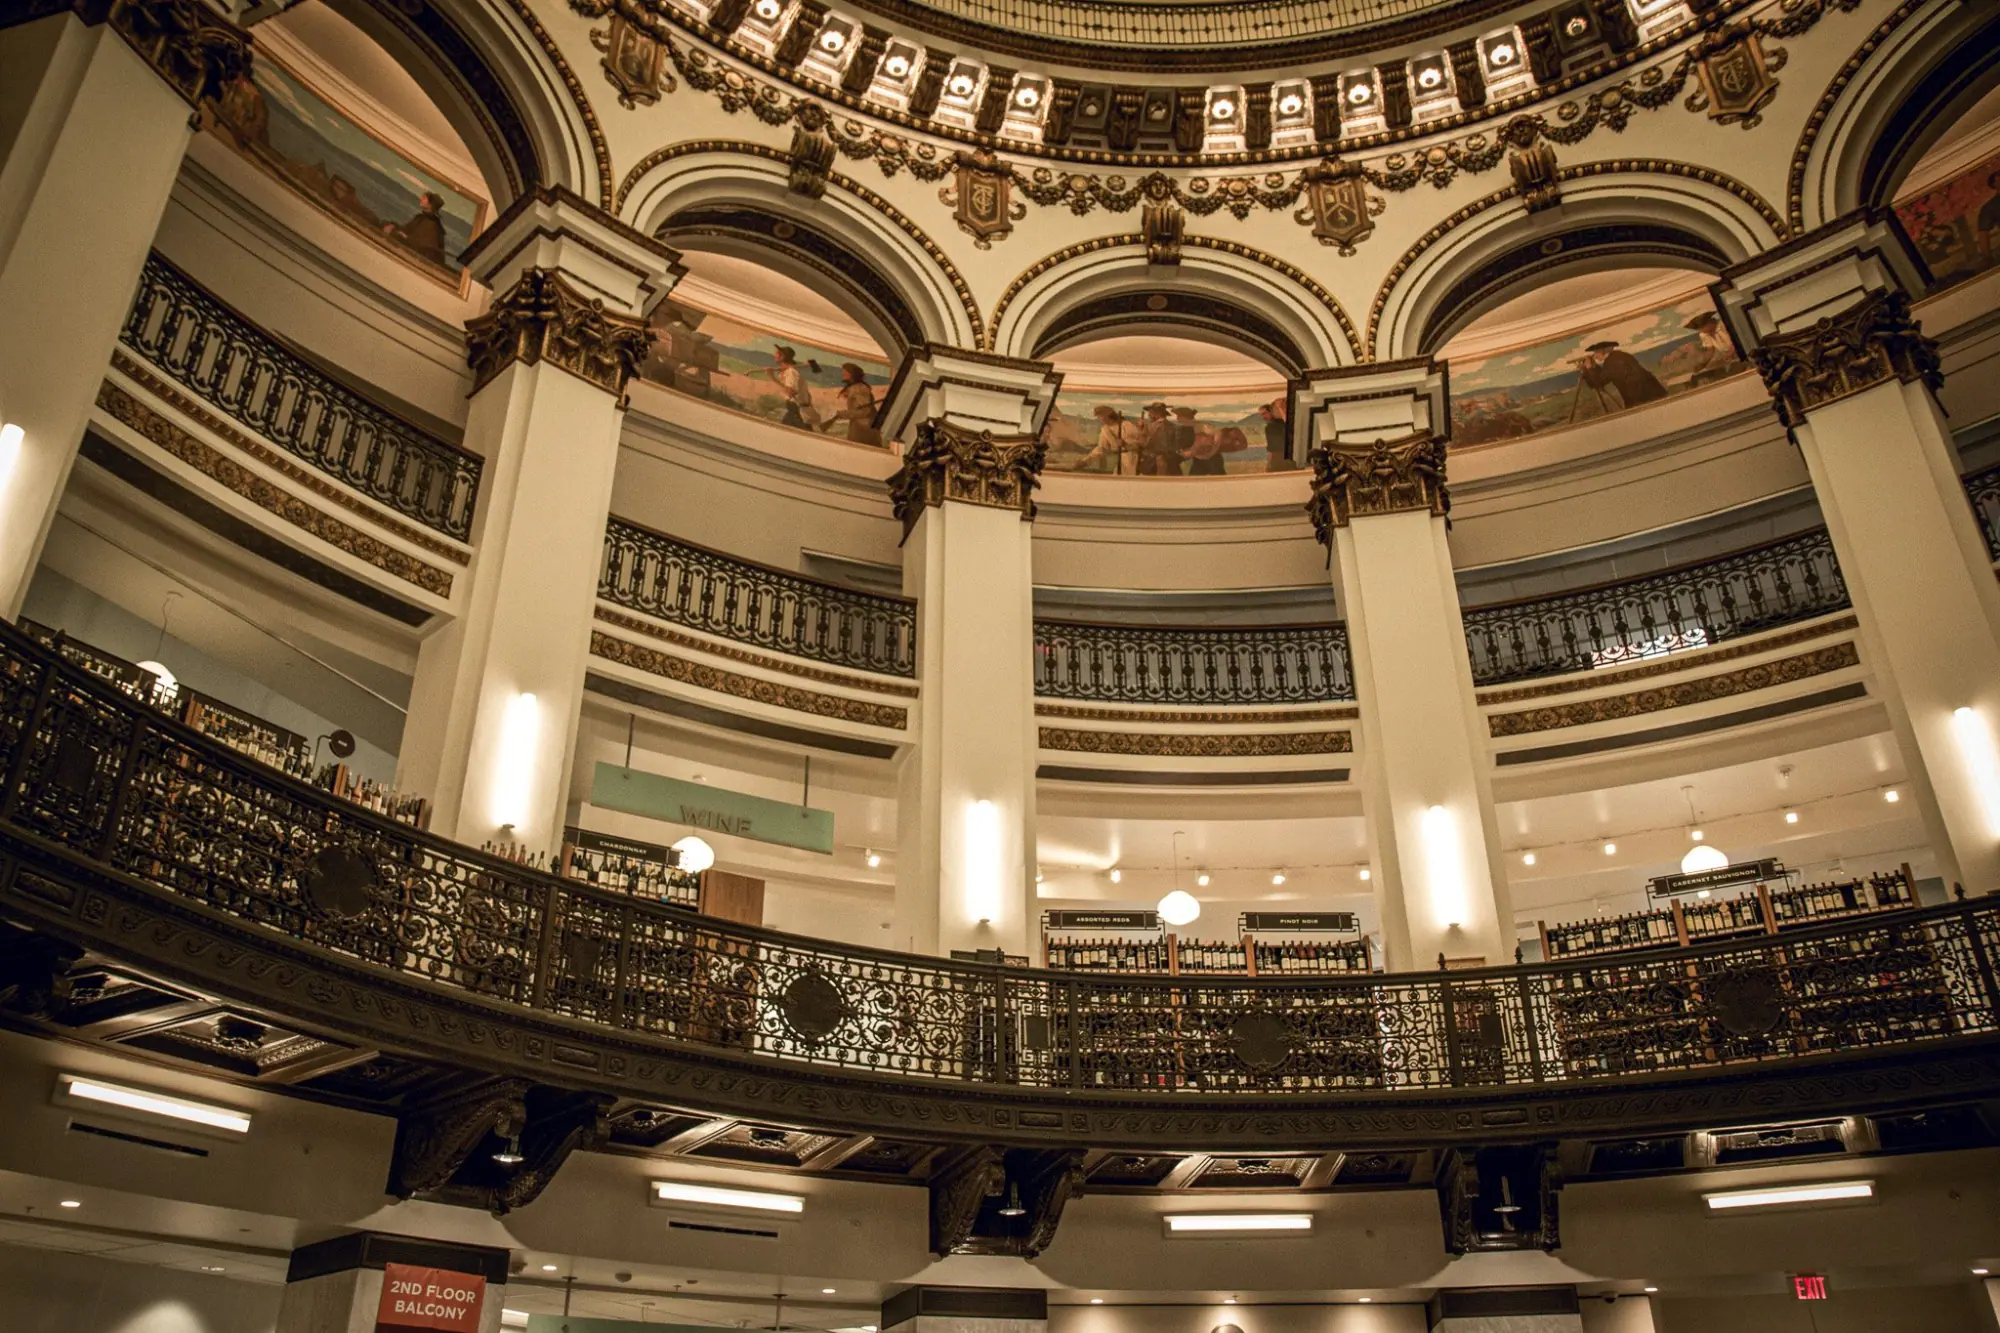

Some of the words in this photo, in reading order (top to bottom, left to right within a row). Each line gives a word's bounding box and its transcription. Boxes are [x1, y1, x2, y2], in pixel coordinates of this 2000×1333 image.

[204, 704, 250, 728] SAUVIGNON
[680, 804, 752, 833] WINE
[599, 840, 648, 854] CHARDONNAY
[1672, 876, 1710, 888] CABERNET
[1712, 869, 1756, 881] SAUVIGNON
[390, 1280, 422, 1296] 2ND
[426, 1285, 476, 1304] FLOOR
[1794, 1276, 1827, 1300] EXIT
[394, 1300, 466, 1320] BALCONY
